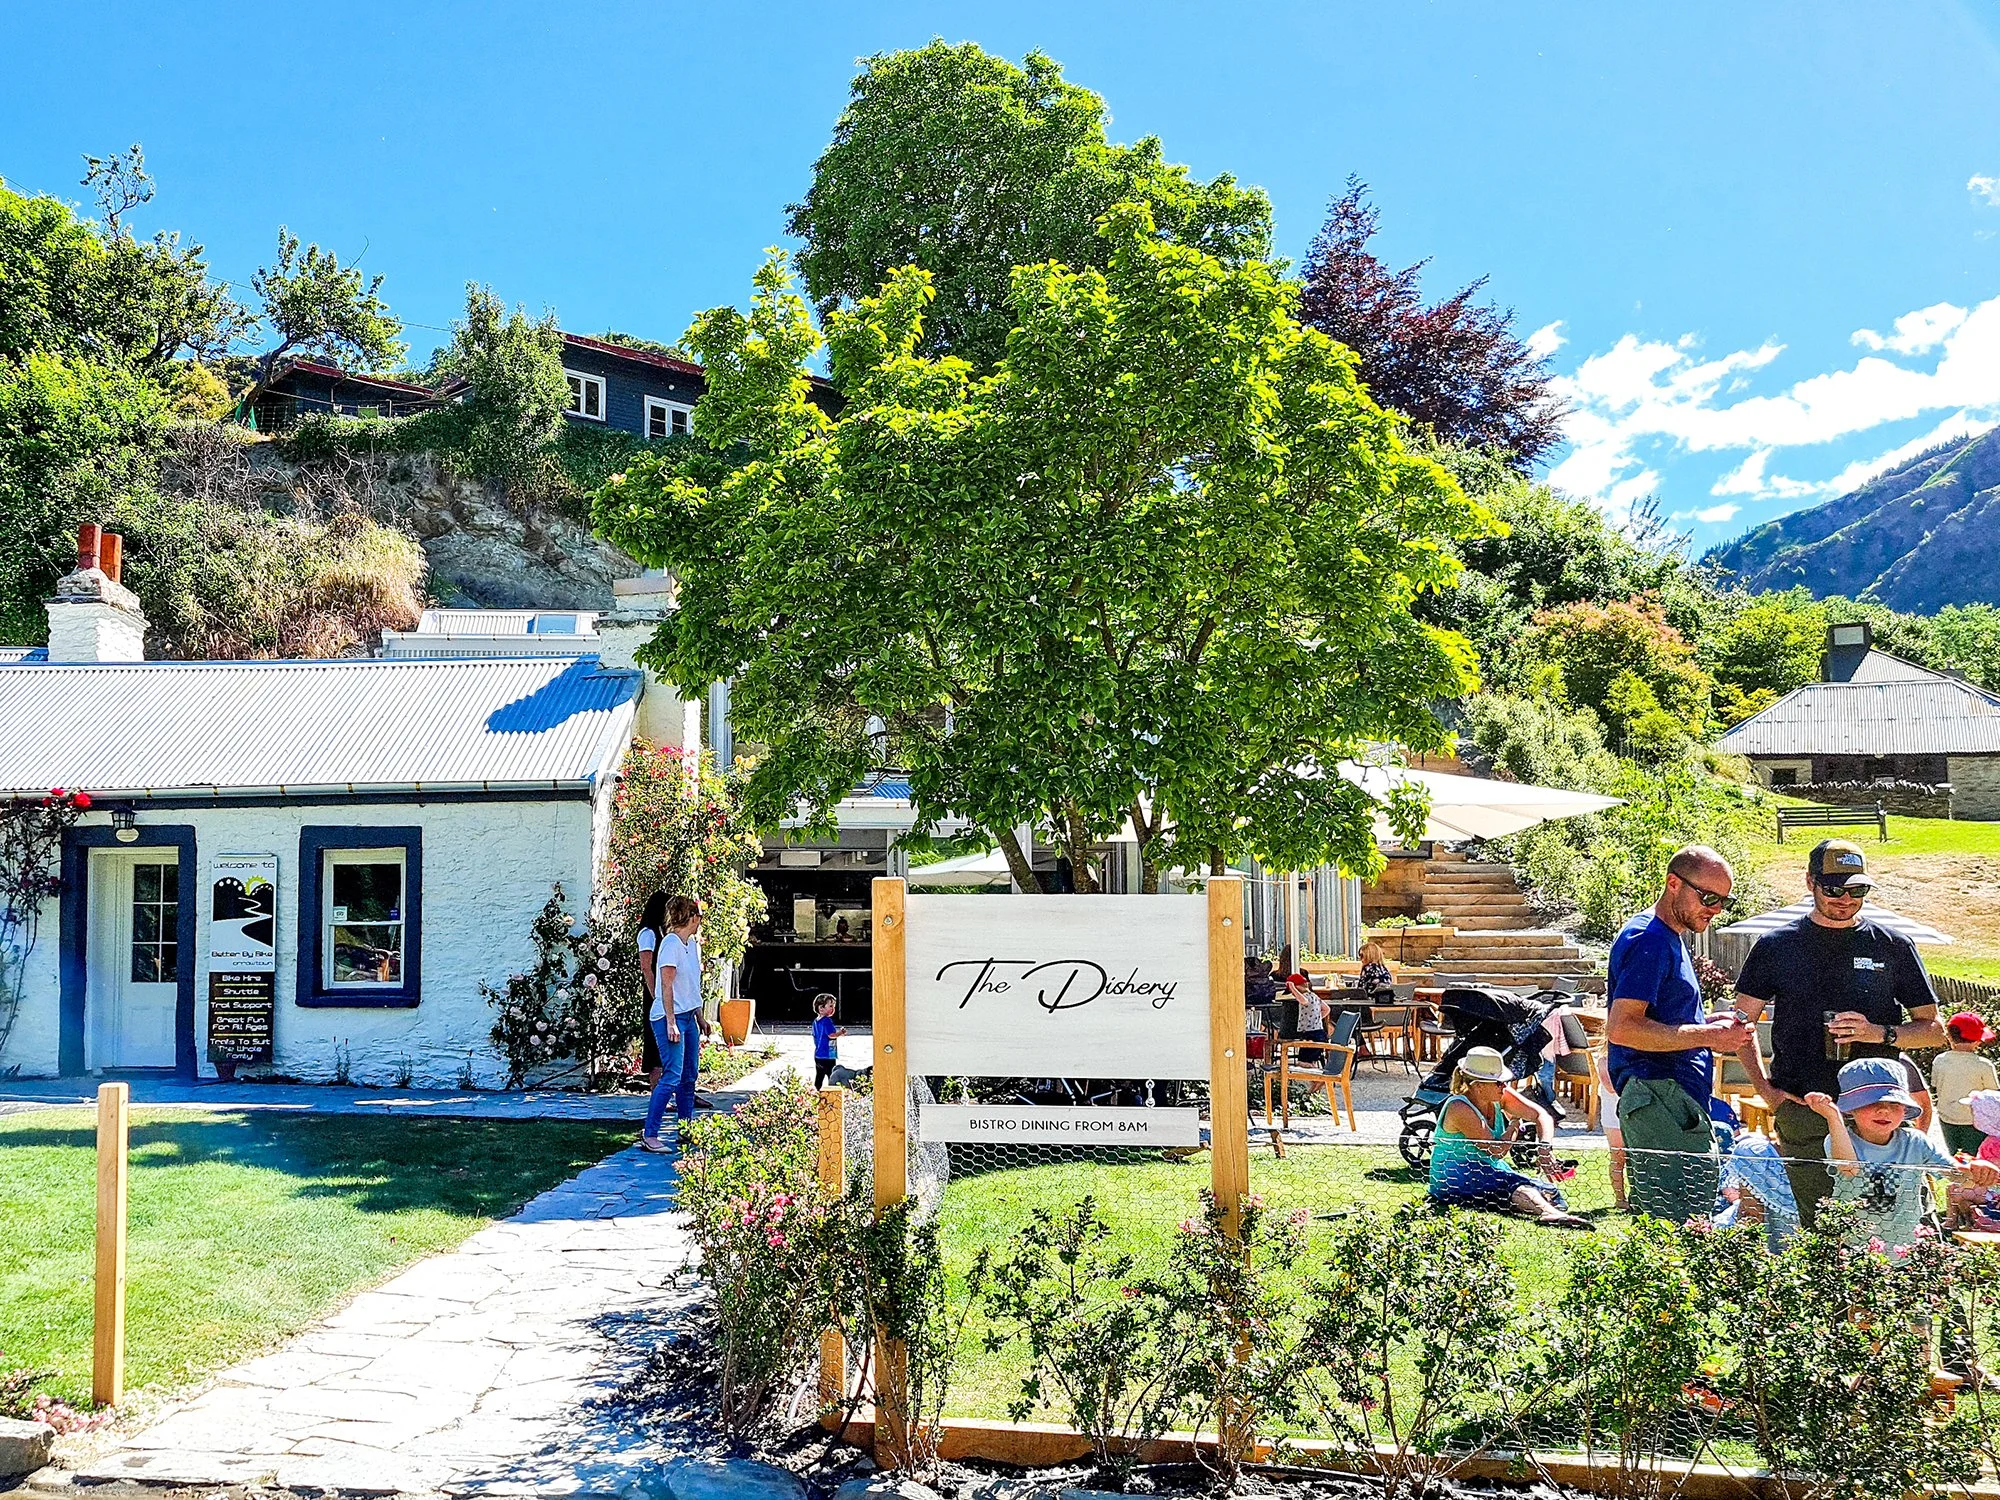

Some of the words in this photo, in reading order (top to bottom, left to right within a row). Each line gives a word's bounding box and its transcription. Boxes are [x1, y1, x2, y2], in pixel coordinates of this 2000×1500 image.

[935, 957, 1036, 1009] The
[1021, 959, 1178, 1014] Dishery
[969, 1119, 1017, 1130] BISTRO
[1021, 1120, 1070, 1131] DINING
[1075, 1120, 1113, 1132] FROM
[1118, 1121, 1148, 1132] 8AM
